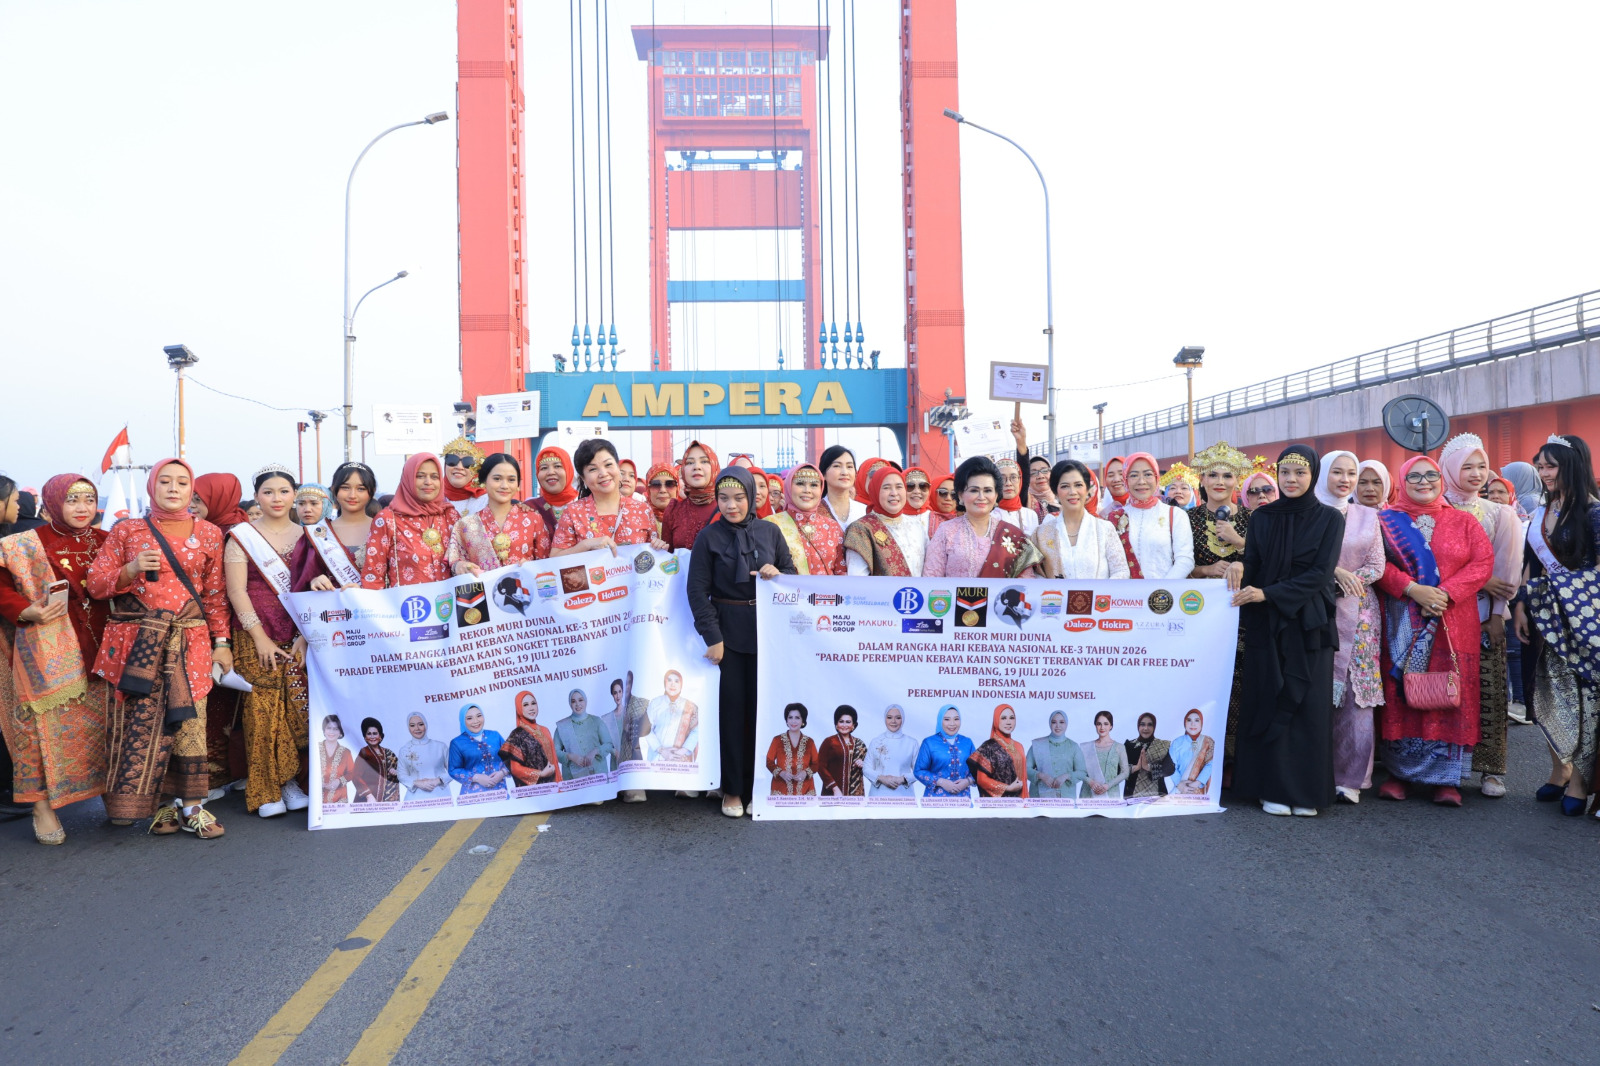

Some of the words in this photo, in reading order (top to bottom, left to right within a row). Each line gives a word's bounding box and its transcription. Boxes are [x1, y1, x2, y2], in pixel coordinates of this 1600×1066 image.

[582, 382, 852, 417] AMPERA
[606, 564, 633, 576] KOWANI
[456, 581, 484, 595] MURI
[601, 588, 626, 600] Hokira
[957, 587, 988, 597] MURI
[566, 594, 594, 607] Dalezz
[1111, 599, 1144, 607] KOWANI
[459, 627, 495, 641] REKOR
[496, 621, 523, 633] MURI
[525, 615, 556, 627] DUNIA
[1066, 620, 1094, 629] Dalezz
[1101, 620, 1130, 629] Hokira
[368, 630, 401, 639] MAKUKU
[371, 653, 403, 663] DALAM
[405, 649, 446, 661] RANGKA
[448, 643, 474, 655] HARI
[475, 634, 515, 650] KEBAYA
[516, 627, 565, 641] NASIONAL
[567, 622, 589, 634] KE-3
[590, 614, 621, 628] TAHUN
[954, 632, 988, 641] REKOR
[991, 633, 1017, 642] MURI
[1020, 633, 1052, 642] DUNIA
[334, 666, 375, 677] "PARADE
[376, 660, 435, 673] PEREMPUAN
[436, 654, 476, 668] KEBAYA
[477, 648, 502, 661] KAIN
[504, 639, 550, 654] SONGKET
[551, 629, 608, 647] TERBANYAK
[611, 625, 622, 635] DI
[858, 642, 894, 651] DALAM
[896, 643, 938, 652] RANGKA
[940, 643, 965, 652] HARI
[968, 644, 1006, 653] KEBAYA
[1008, 645, 1059, 654] NASIONAL
[1061, 645, 1083, 654] KE-3
[1086, 646, 1120, 655] TAHUN
[1122, 646, 1147, 655] 2026
[450, 656, 516, 678] PALEMBANG,
[517, 654, 529, 663] 19
[531, 650, 550, 663] JULI
[552, 647, 576, 658] 2026
[816, 653, 860, 662] "PARADE
[862, 654, 924, 663] PEREMPUAN
[926, 655, 964, 663] KEBAYA
[967, 655, 992, 664] KAIN
[994, 656, 1041, 665] SONGKET
[1043, 657, 1103, 666] TERBANYAK
[1107, 657, 1118, 666] DI
[1120, 658, 1140, 667] CAR
[1143, 658, 1168, 667] FREE
[1170, 658, 1195, 668] DAY"
[493, 664, 541, 680] BERSAMA
[938, 666, 1002, 677] PALEMBANG,
[1005, 667, 1017, 676] 19
[1019, 668, 1039, 677] JULI
[1041, 668, 1067, 677] 2026
[424, 686, 487, 704] PEREMPUAN
[489, 675, 543, 692] INDONESIA
[545, 670, 570, 683] MAJU
[571, 663, 608, 678] SUMSEL
[978, 678, 1026, 688] BERSAMA
[907, 689, 969, 698] PEREMPUAN
[972, 690, 1027, 699] INDONESIA
[1029, 691, 1055, 700] MAJU
[1057, 691, 1096, 700] SUMSEL
